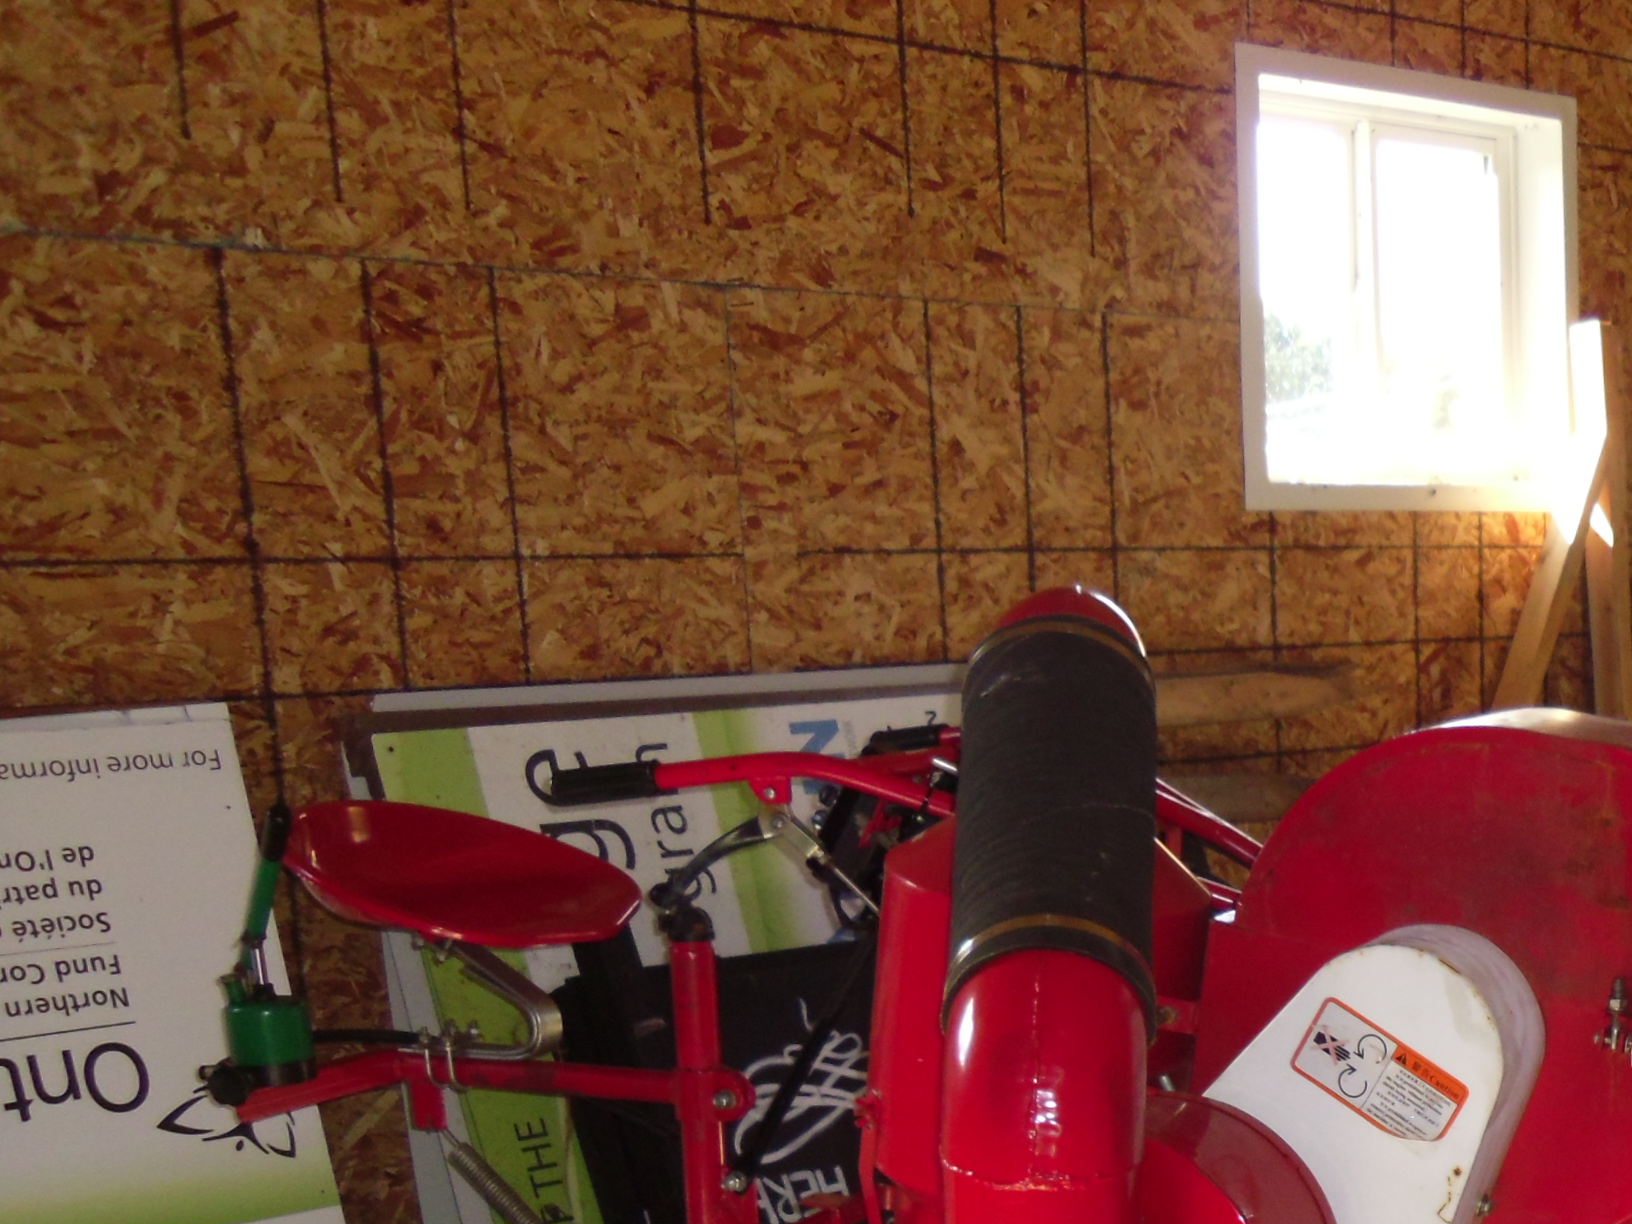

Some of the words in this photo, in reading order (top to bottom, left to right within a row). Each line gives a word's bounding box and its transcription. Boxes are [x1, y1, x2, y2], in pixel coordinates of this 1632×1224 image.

[107, 753, 174, 772] more
[182, 749, 222, 771] For
[61, 845, 95, 868] de
[0, 876, 59, 909] patr
[68, 878, 102, 900] du
[12, 912, 112, 943] Société
[54, 954, 122, 983] Fund
[4, 986, 130, 1018] Northern
[0, 1041, 150, 1123] Ont
[513, 1117, 563, 1198] THE
